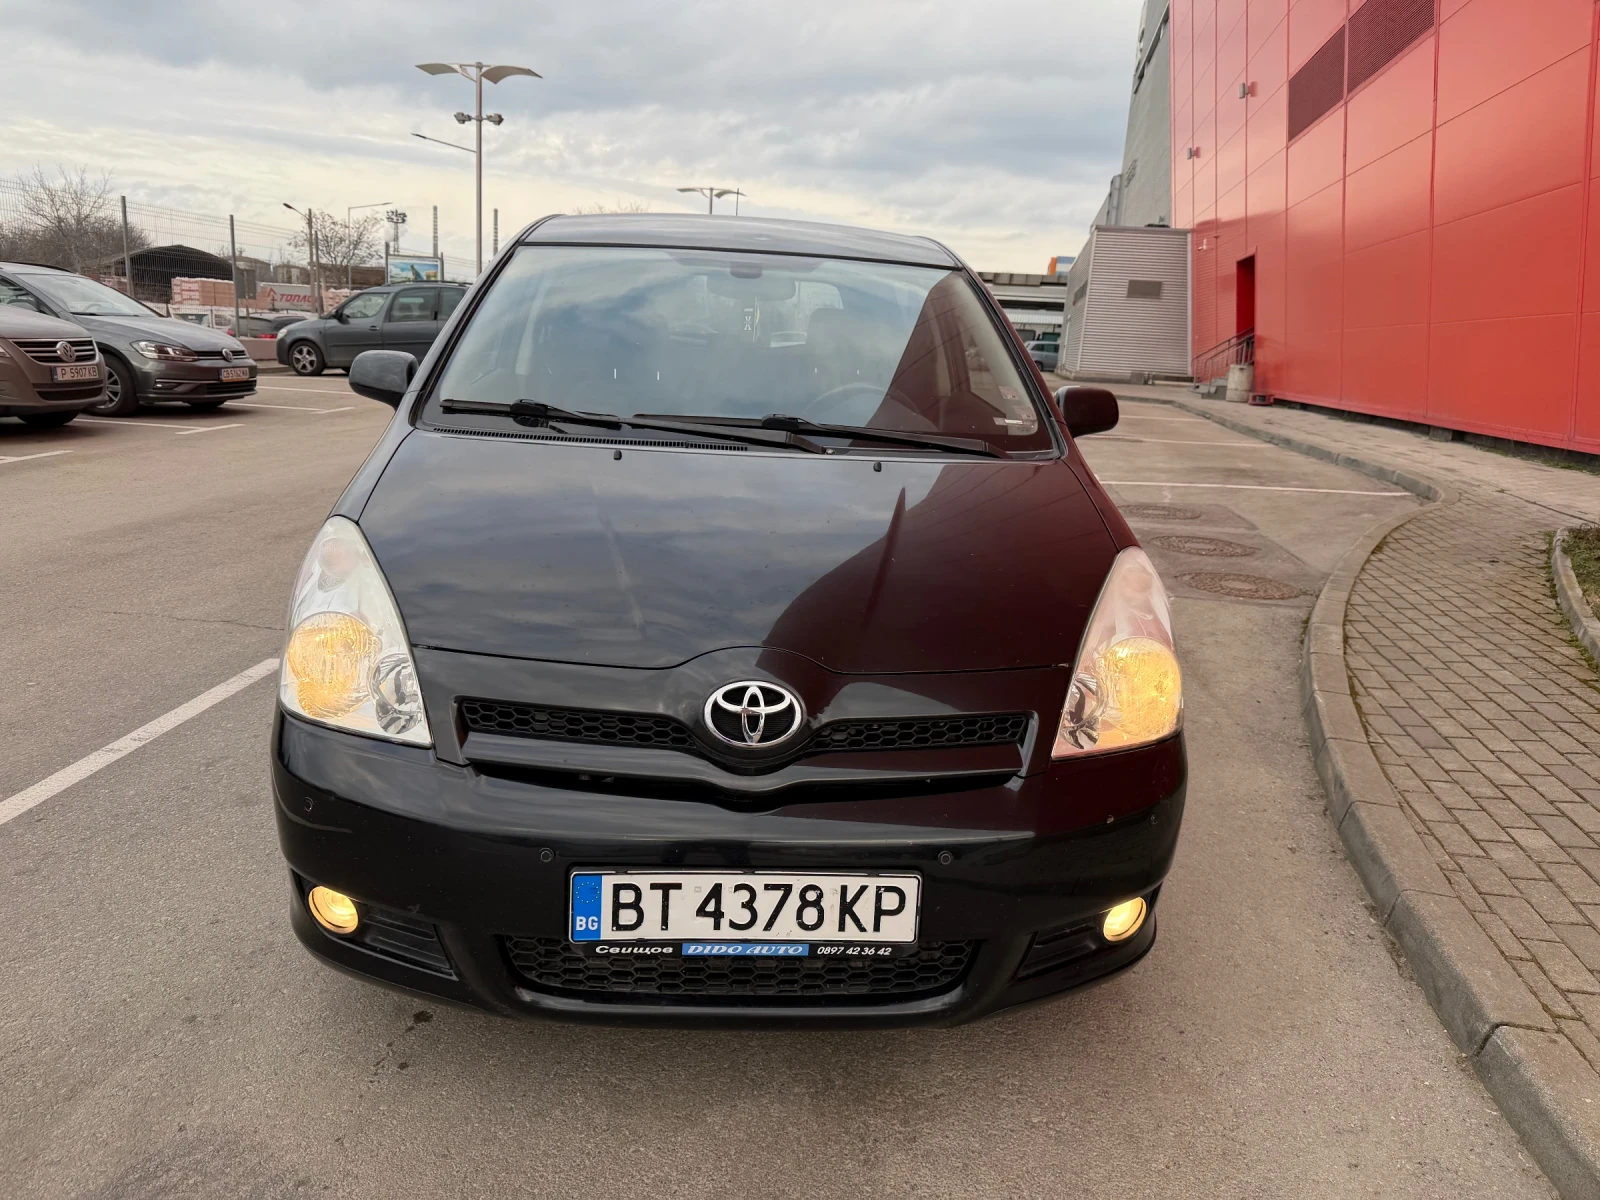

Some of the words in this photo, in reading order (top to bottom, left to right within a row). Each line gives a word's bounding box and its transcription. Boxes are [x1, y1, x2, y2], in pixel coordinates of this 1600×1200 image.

[61, 368, 67, 378] P
[70, 367, 87, 378] 5907
[611, 882, 683, 932] BT
[695, 882, 825, 932] 4378
[837, 884, 907, 933] KP
[575, 916, 599, 931] BG
[595, 945, 674, 955] Свищов
[687, 945, 743, 954] DIDO
[746, 944, 804, 955] AUTO
[817, 946, 845, 955] 0897
[846, 947, 861, 956] 42
[861, 947, 876, 956] 36
[877, 947, 892, 957] 42
